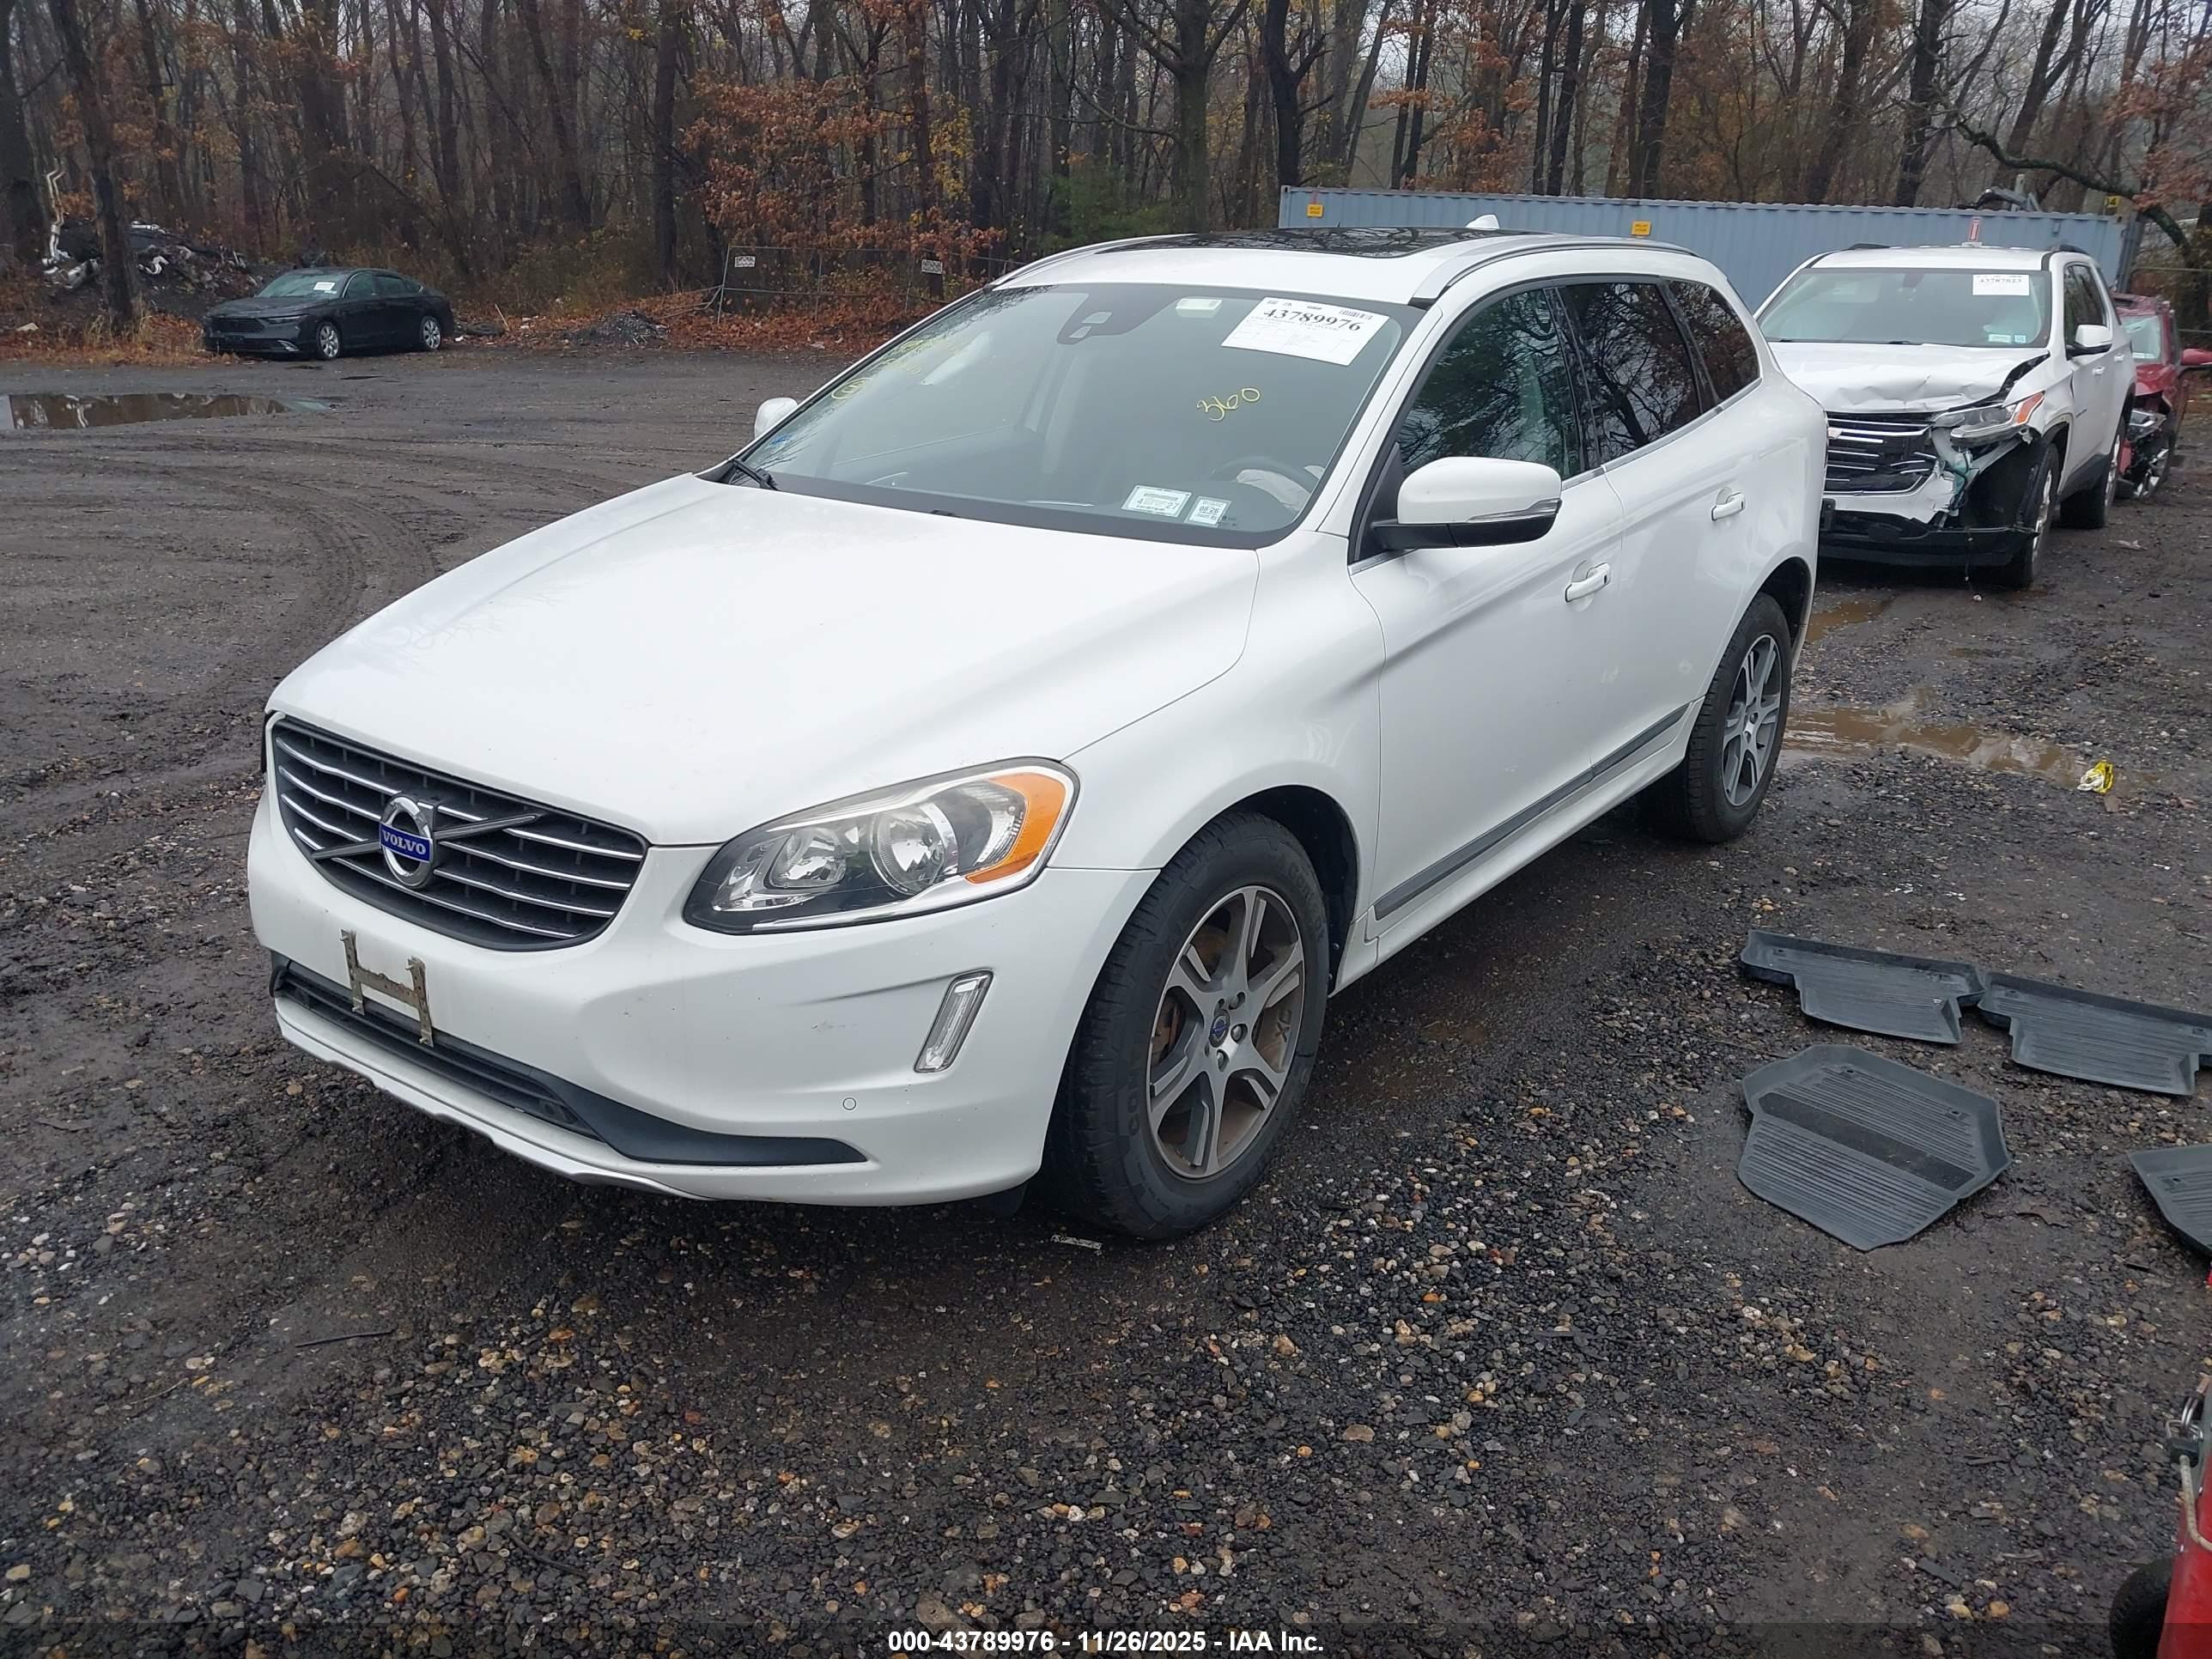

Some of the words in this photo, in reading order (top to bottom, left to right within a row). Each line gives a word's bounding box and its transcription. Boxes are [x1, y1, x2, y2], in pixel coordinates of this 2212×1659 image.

[1263, 308, 1363, 331] 43789976
[1196, 387, 1261, 421] 360
[381, 830, 427, 855] VOLVO
